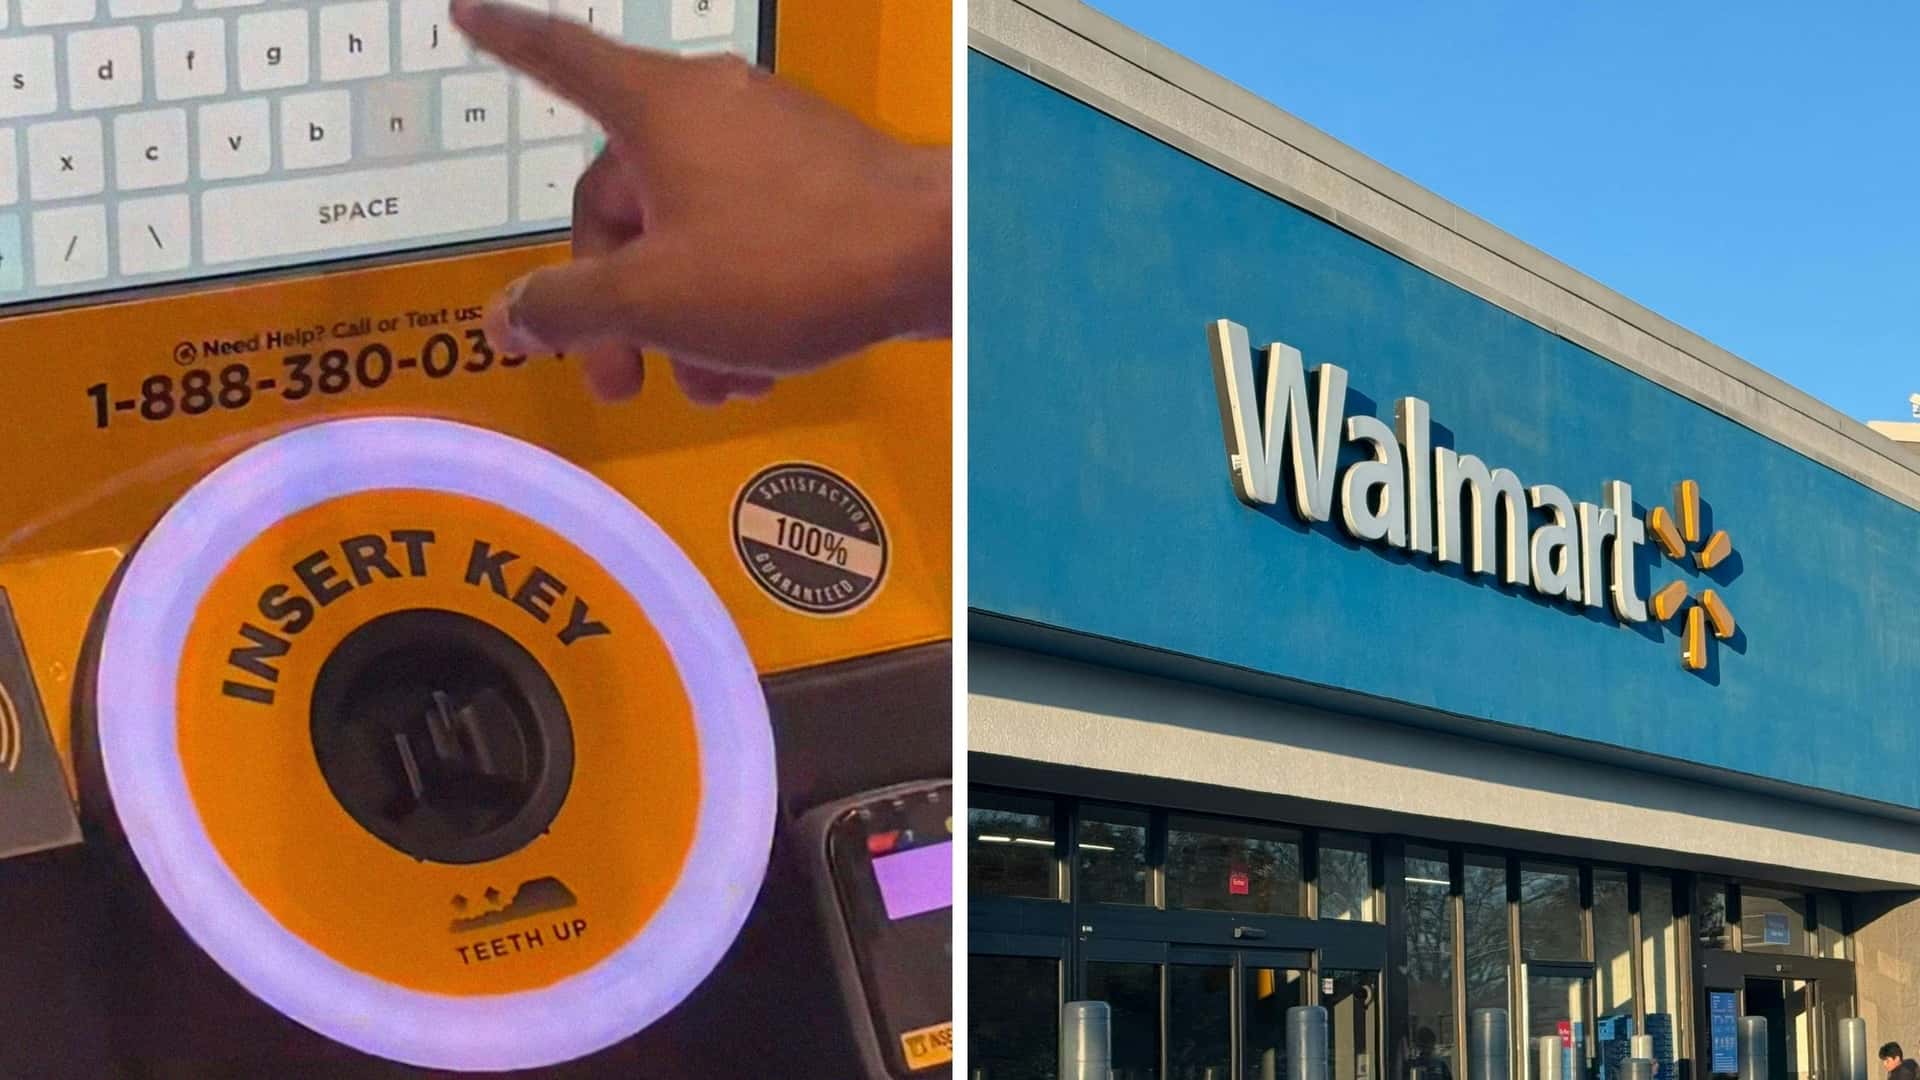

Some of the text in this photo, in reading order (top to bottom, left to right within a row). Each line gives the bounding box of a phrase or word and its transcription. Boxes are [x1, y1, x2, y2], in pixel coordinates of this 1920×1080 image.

[13, 73, 25, 89] s
[97, 59, 113, 81] d
[186, 50, 195, 71] f
[266, 47, 282, 66] g
[348, 33, 363, 53] h
[60, 157, 74, 171] x
[145, 146, 159, 161] c
[228, 135, 242, 151] v
[309, 122, 324, 142] b
[390, 117, 403, 132] n
[465, 108, 486, 123] m
[319, 197, 399, 224] SPACE
[203, 305, 483, 358] Need Help? Call or Text us:
[87, 328, 567, 430] 1-888-380-03
[1206, 319, 1648, 624] Walmart
[758, 476, 872, 533] SATISFACTION
[776, 517, 849, 567] 100%
[755, 552, 854, 604] GUARANTEED
[222, 529, 612, 705] INSERT KEY
[456, 919, 587, 965] TEETH UP
